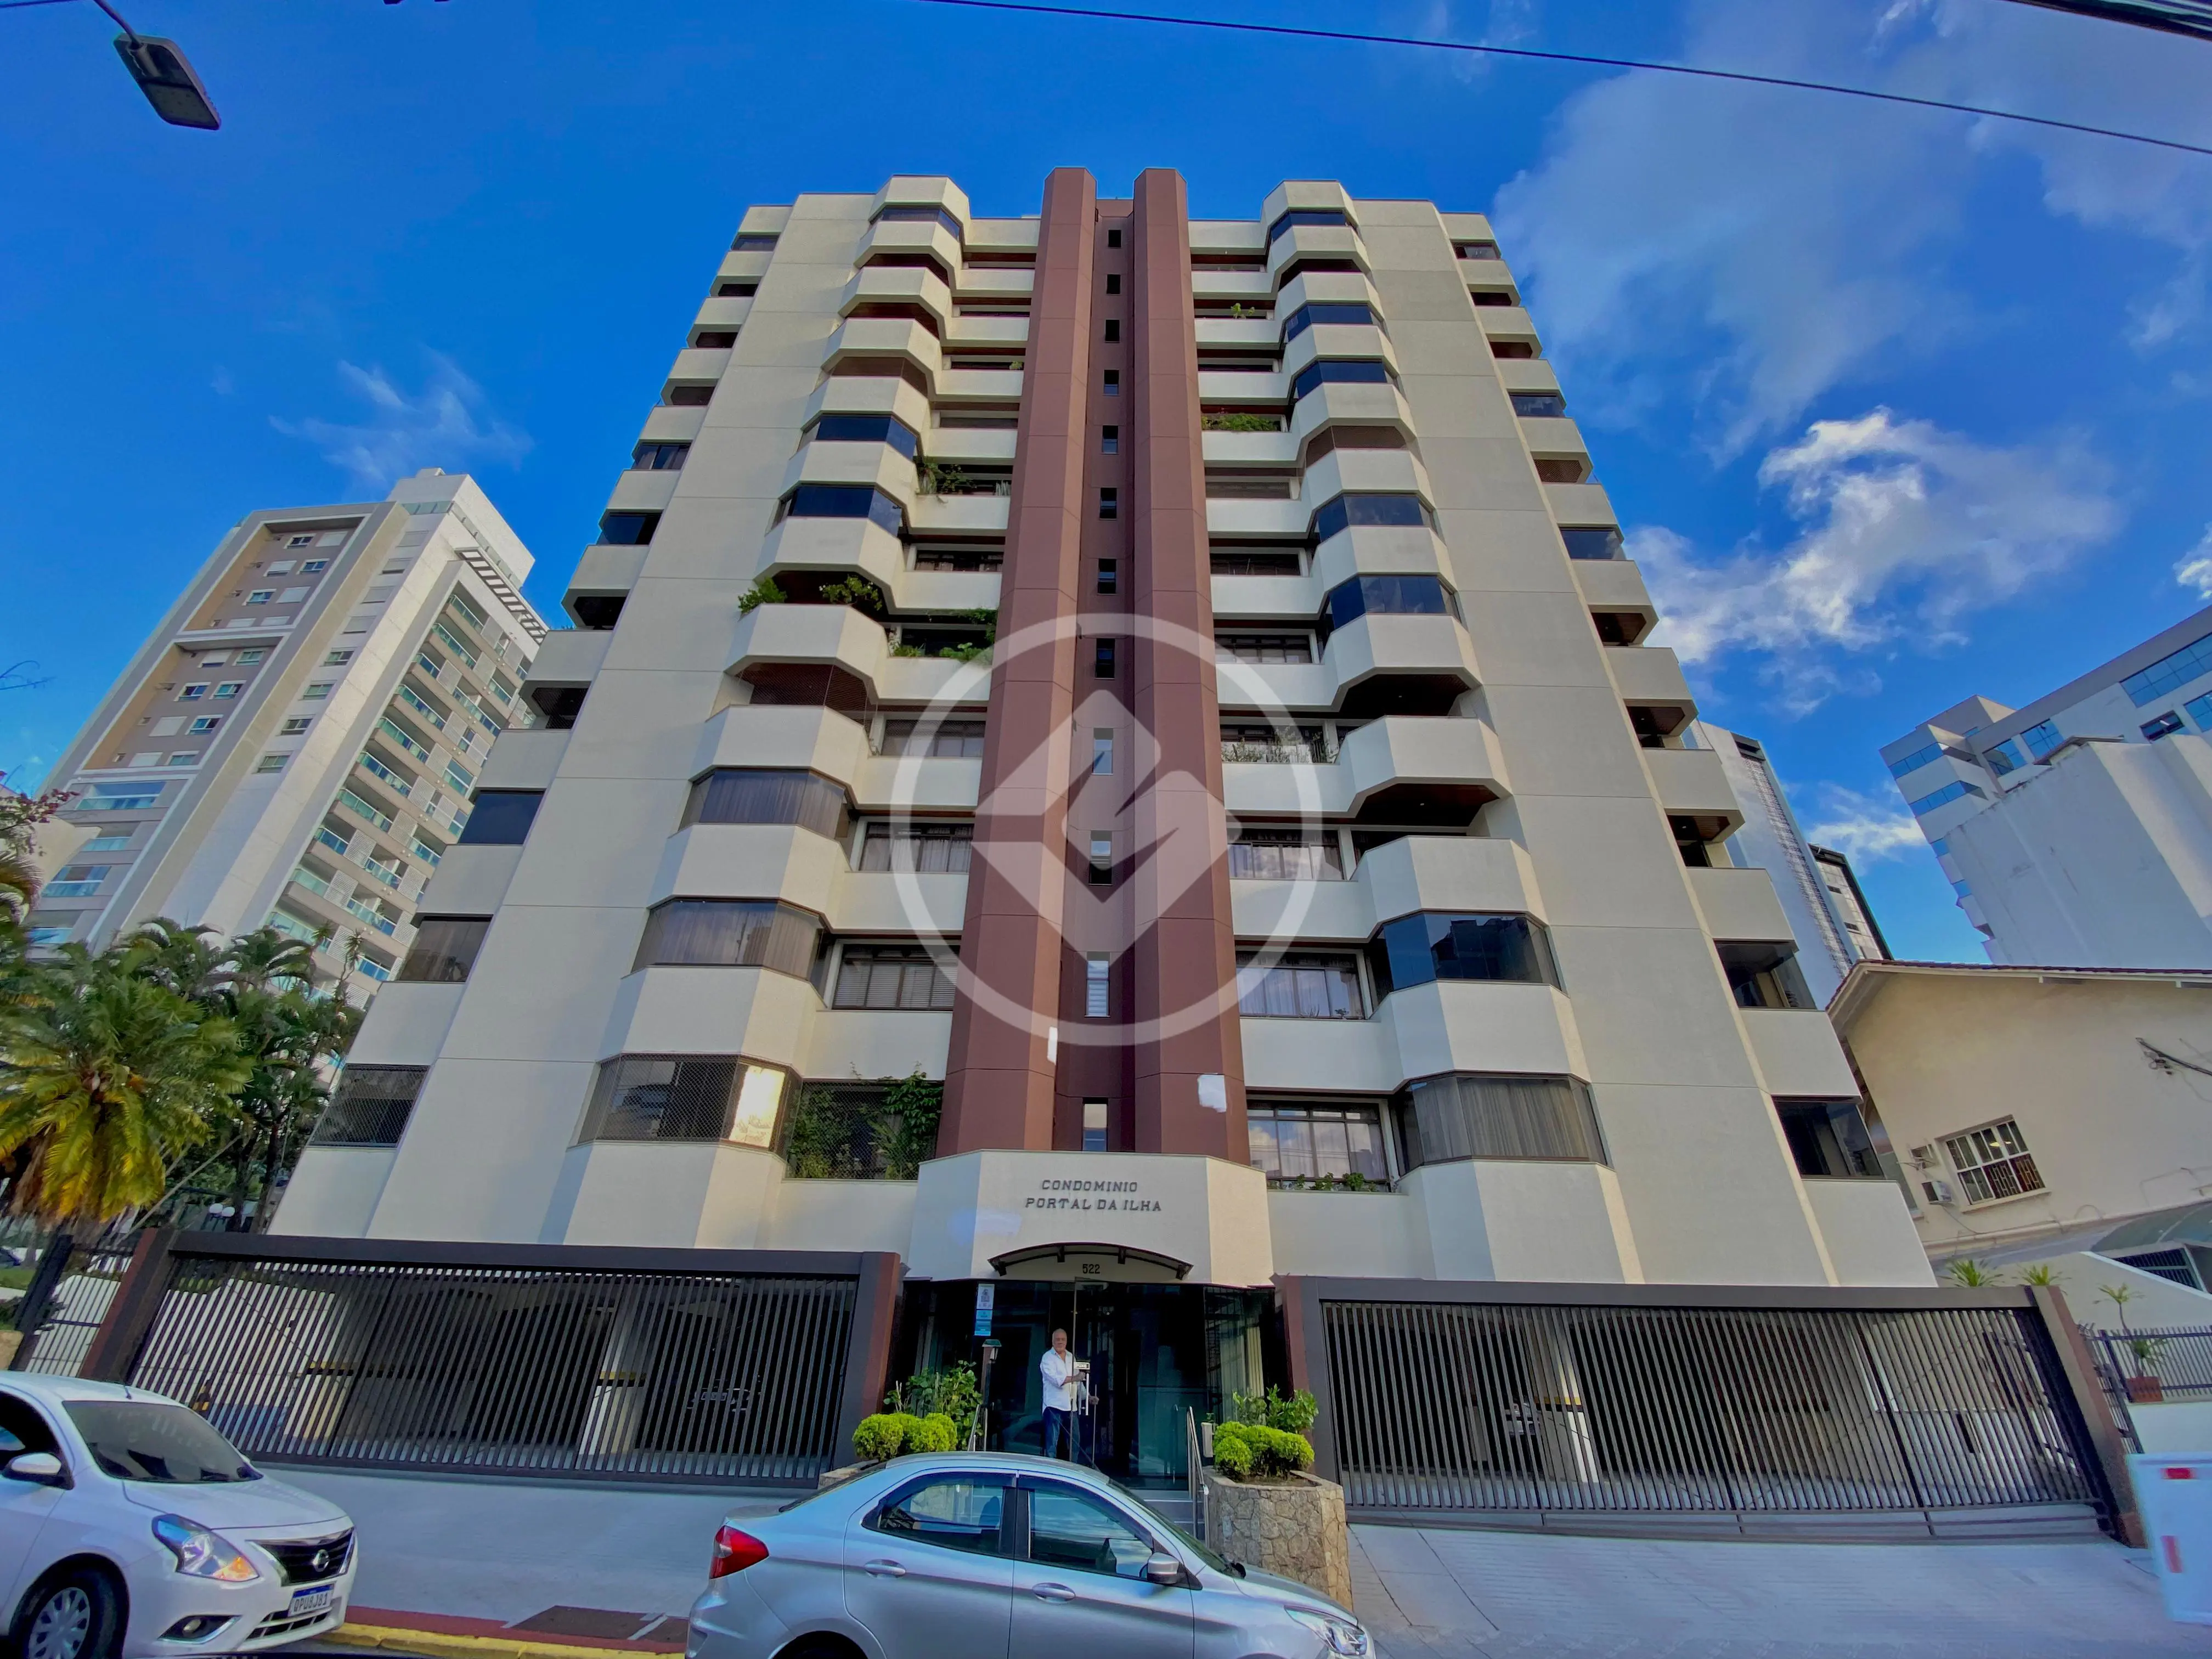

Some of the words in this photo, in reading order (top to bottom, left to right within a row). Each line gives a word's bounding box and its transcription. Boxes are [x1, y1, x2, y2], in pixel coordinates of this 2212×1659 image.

[1042, 1180, 1138, 1192] CONDOMINIO
[1025, 1198, 1092, 1209] PORTAL
[1097, 1199, 1117, 1210] DA
[1123, 1200, 1161, 1211] ILHA
[1082, 1263, 1101, 1274] 522
